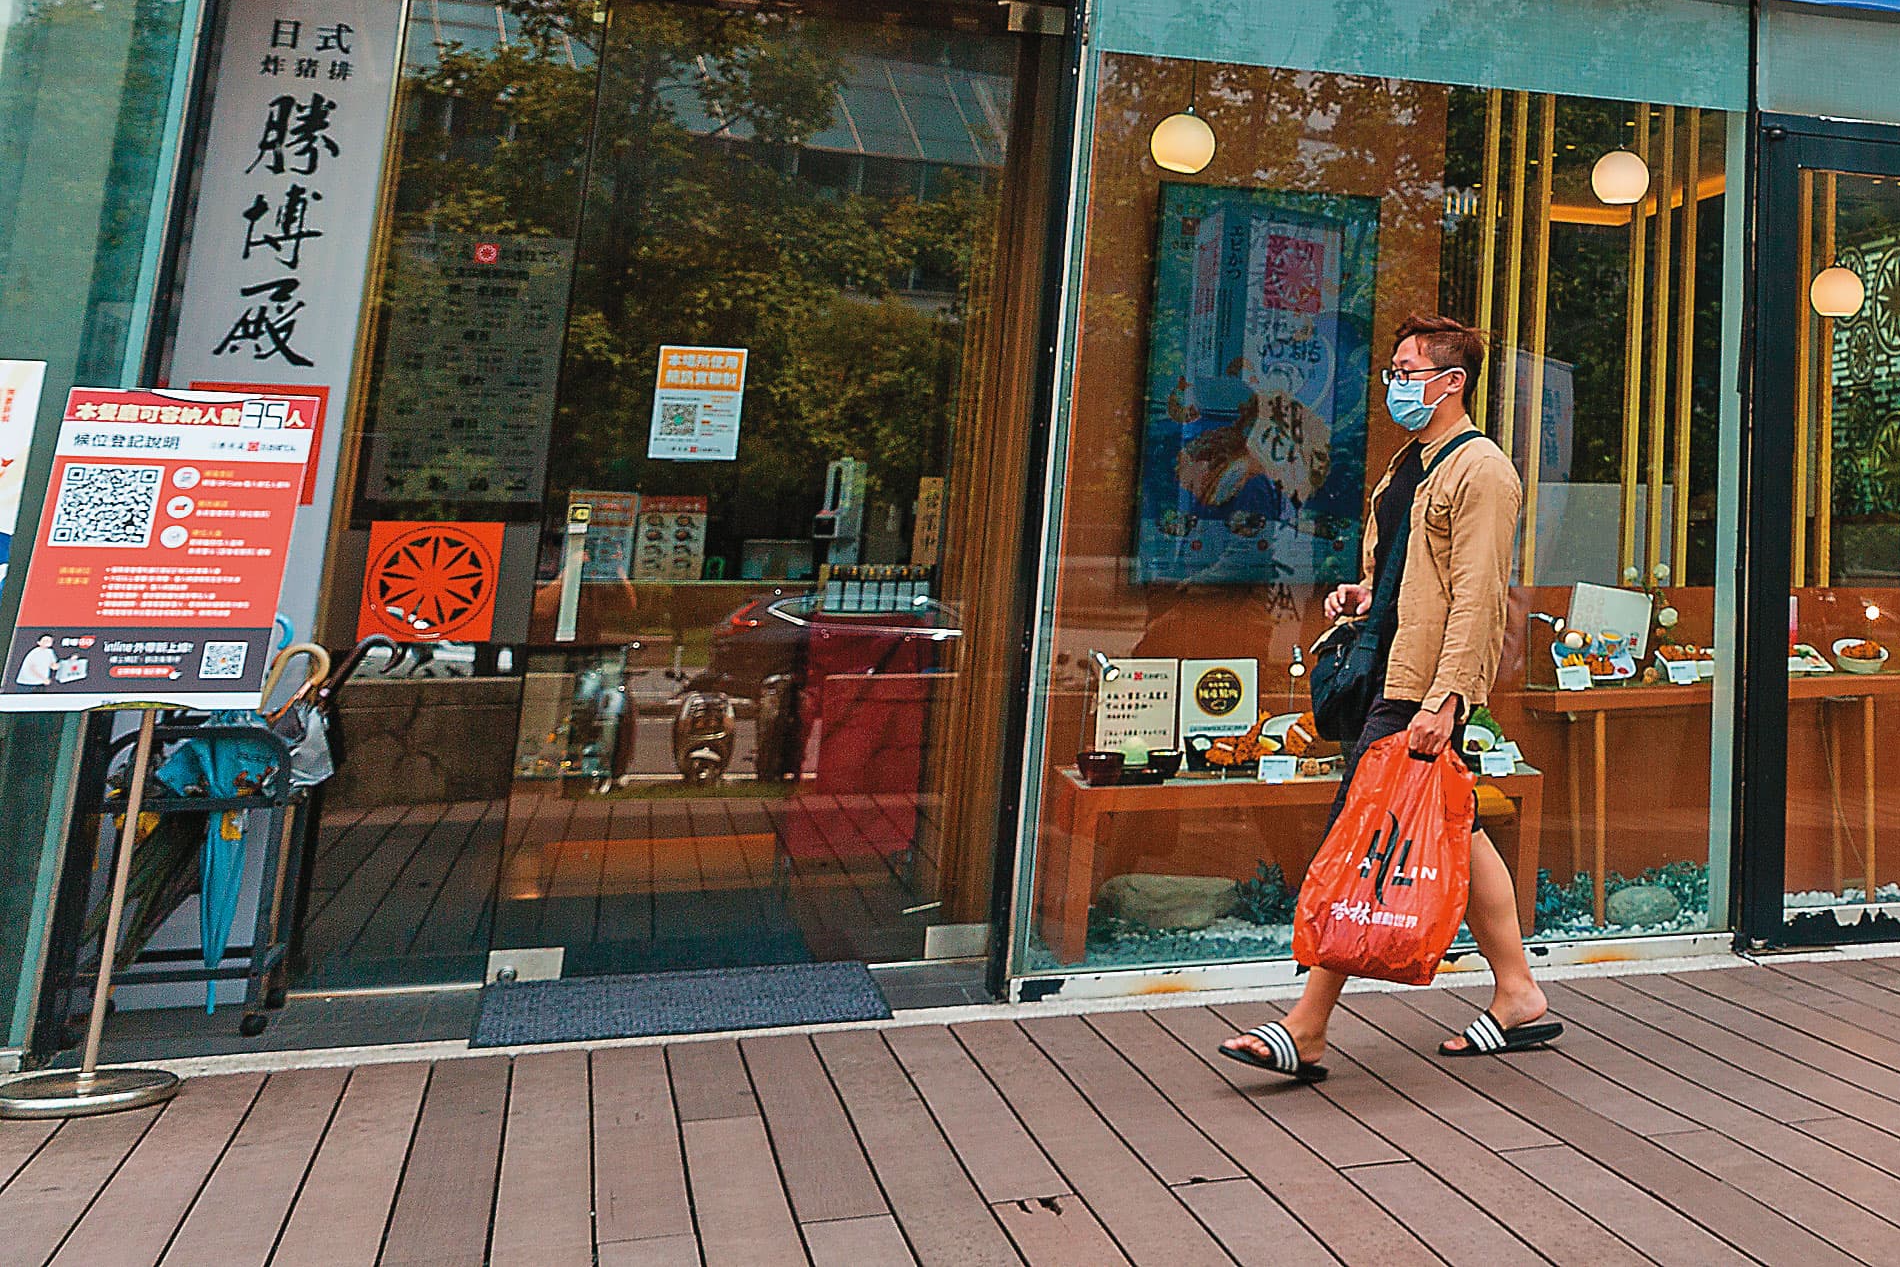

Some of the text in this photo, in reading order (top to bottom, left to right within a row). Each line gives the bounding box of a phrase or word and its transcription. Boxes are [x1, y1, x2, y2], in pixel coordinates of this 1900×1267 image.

[270, 19, 354, 54] 日式
[213, 92, 340, 368] 勝博殿
[285, 410, 305, 427] 人
